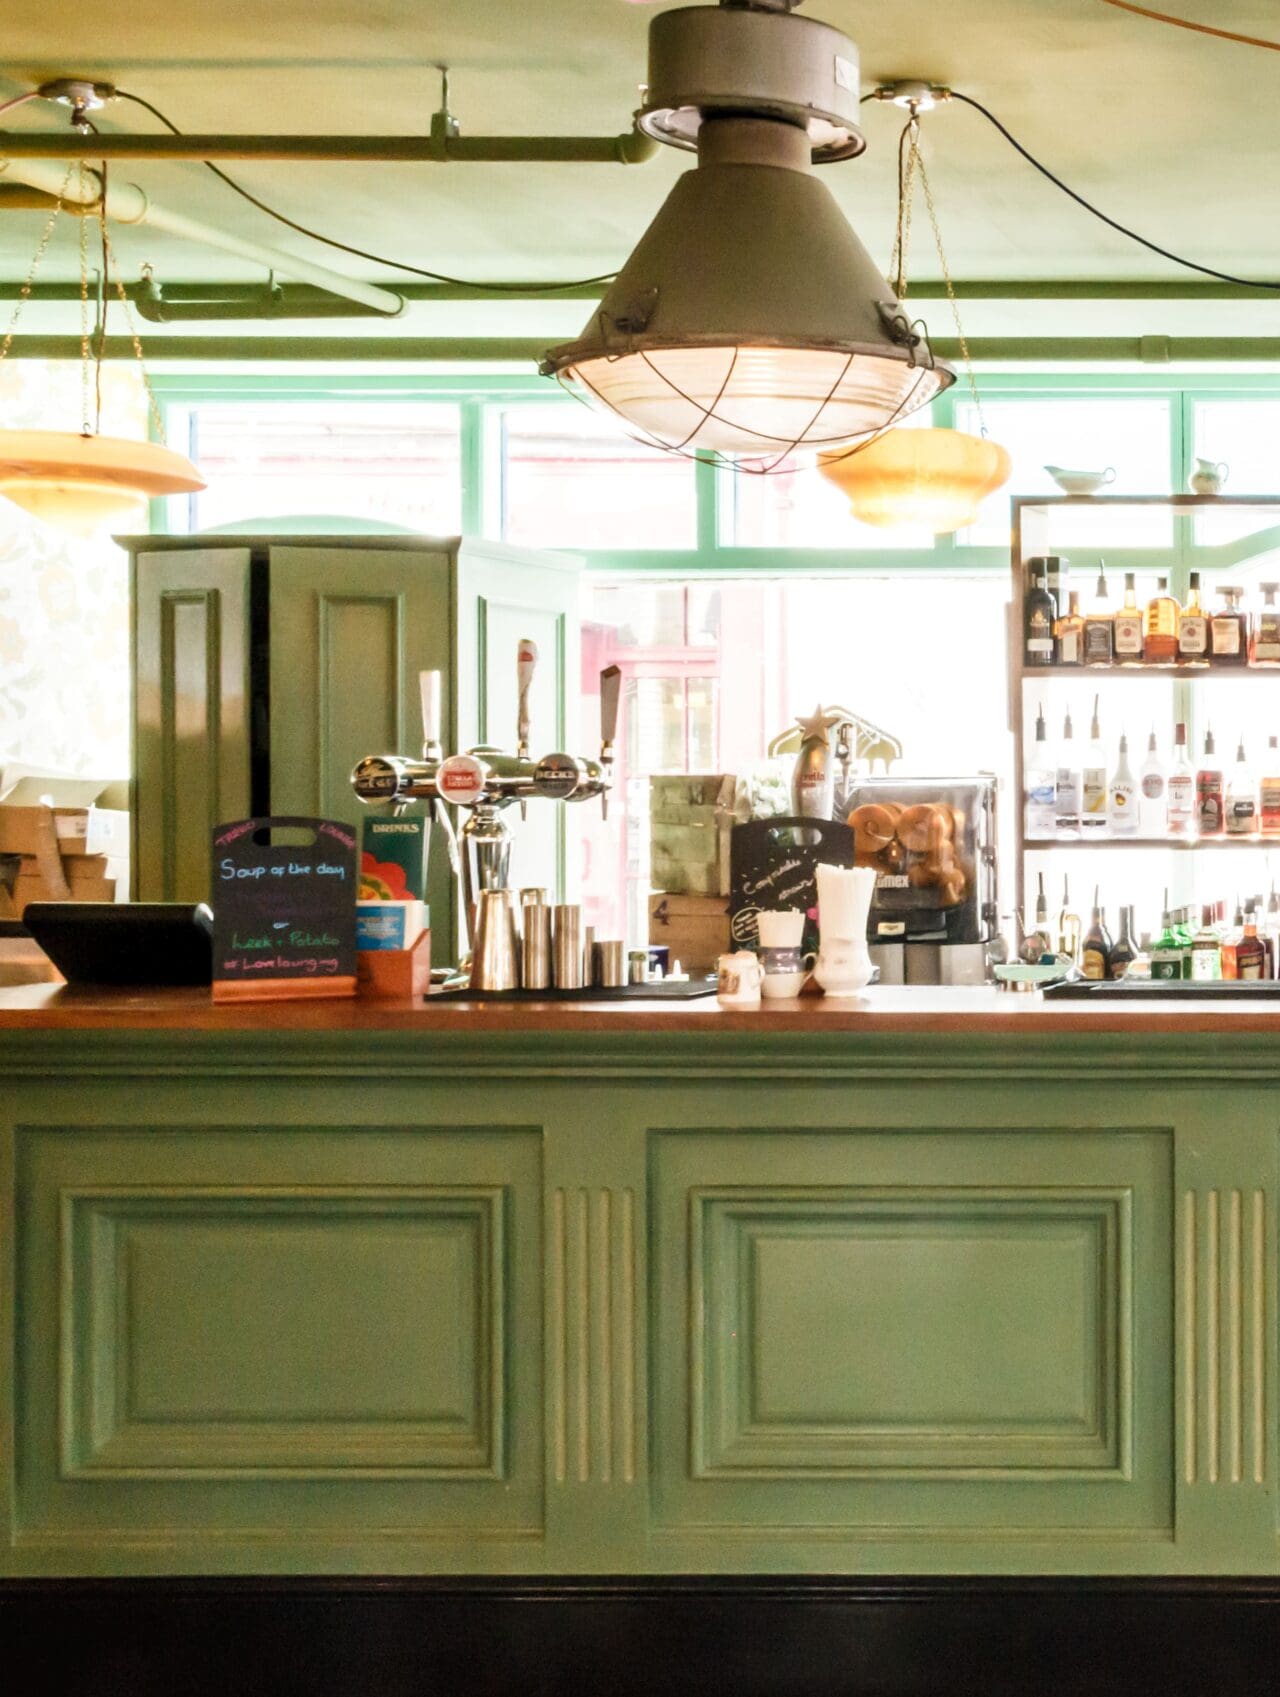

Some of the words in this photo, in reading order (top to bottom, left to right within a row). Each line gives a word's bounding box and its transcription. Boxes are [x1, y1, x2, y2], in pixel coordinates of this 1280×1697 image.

[372, 823, 419, 833] DRINKS
[221, 859, 266, 879] Soup
[270, 866, 285, 877] of
[288, 863, 311, 874] the
[316, 863, 345, 880] day
[232, 932, 273, 949] Leek
[289, 931, 340, 947] Potato
